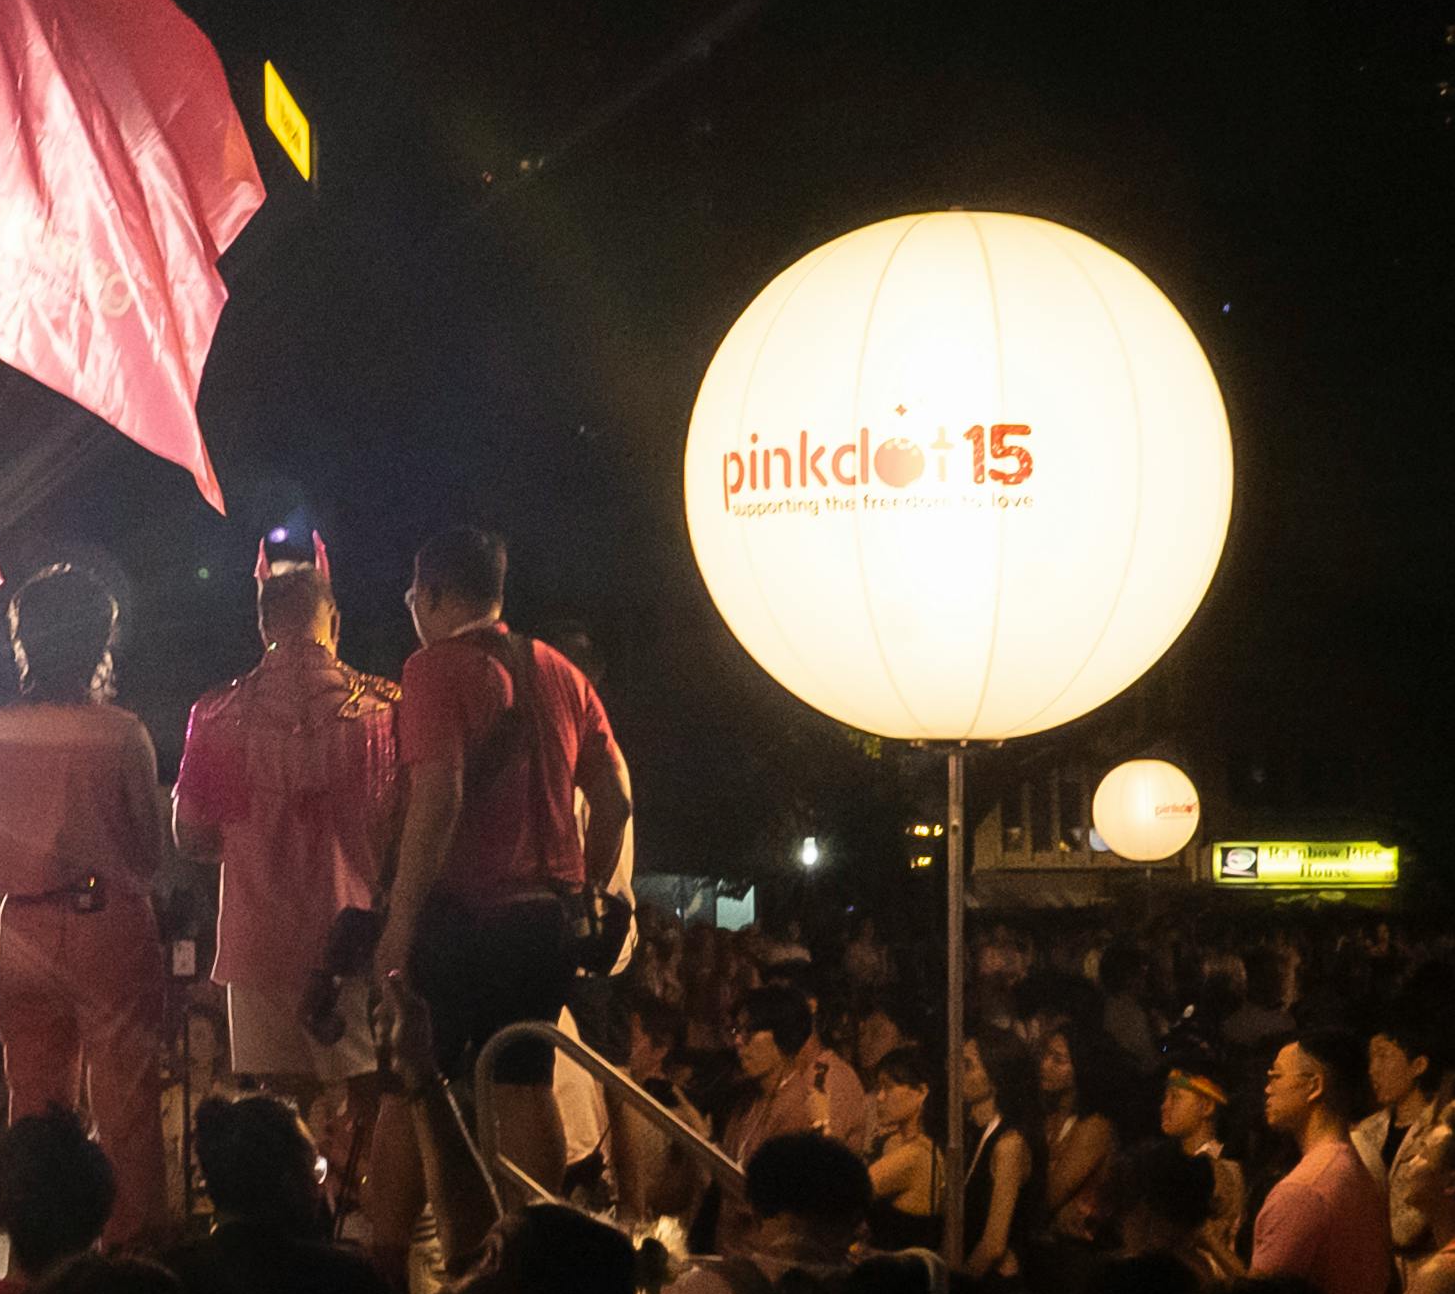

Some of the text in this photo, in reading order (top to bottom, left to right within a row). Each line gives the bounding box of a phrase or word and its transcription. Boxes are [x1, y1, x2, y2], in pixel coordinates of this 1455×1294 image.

[963, 423, 1034, 486] 15
[732, 497, 819, 518] upporting
[825, 495, 857, 511] the
[990, 491, 1034, 509] love
